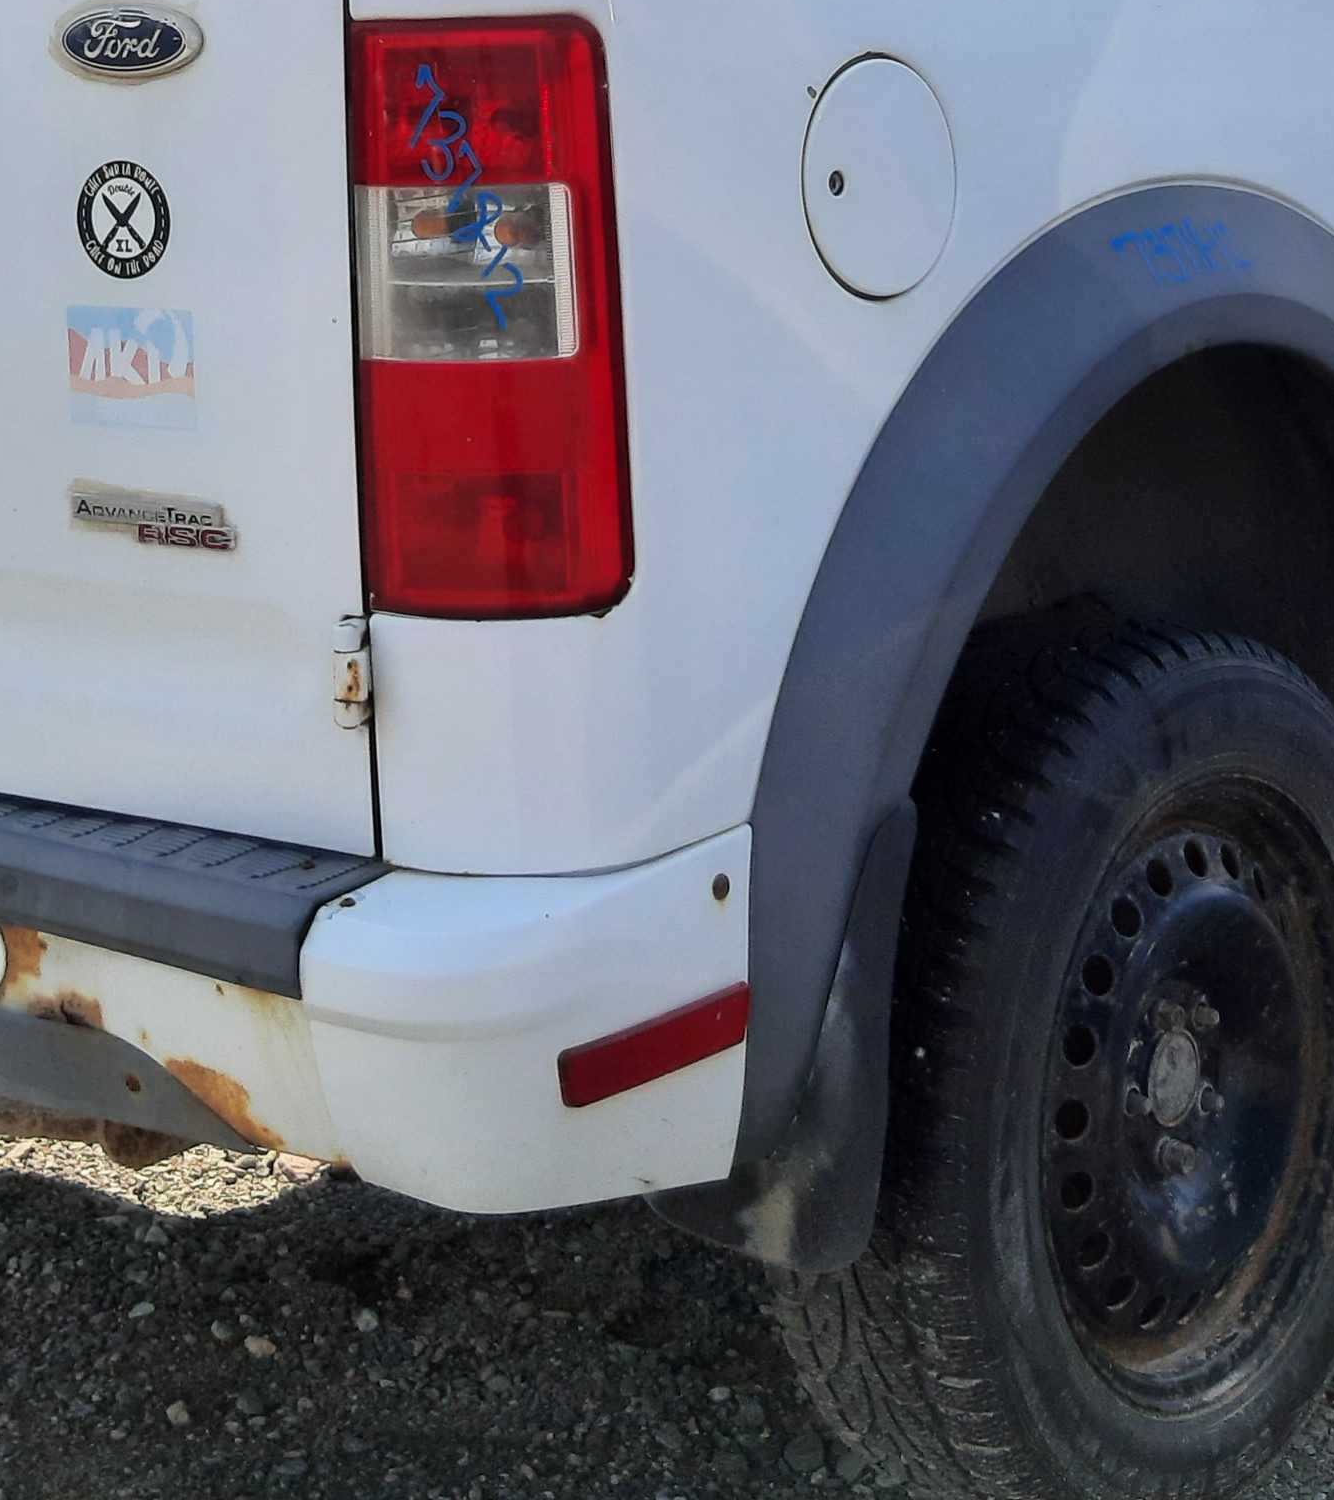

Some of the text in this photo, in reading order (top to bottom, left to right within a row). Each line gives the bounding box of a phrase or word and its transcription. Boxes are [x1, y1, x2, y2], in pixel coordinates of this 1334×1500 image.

[83, 18, 161, 60] Ford
[115, 238, 133, 253] XL
[137, 523, 236, 551] RSC
